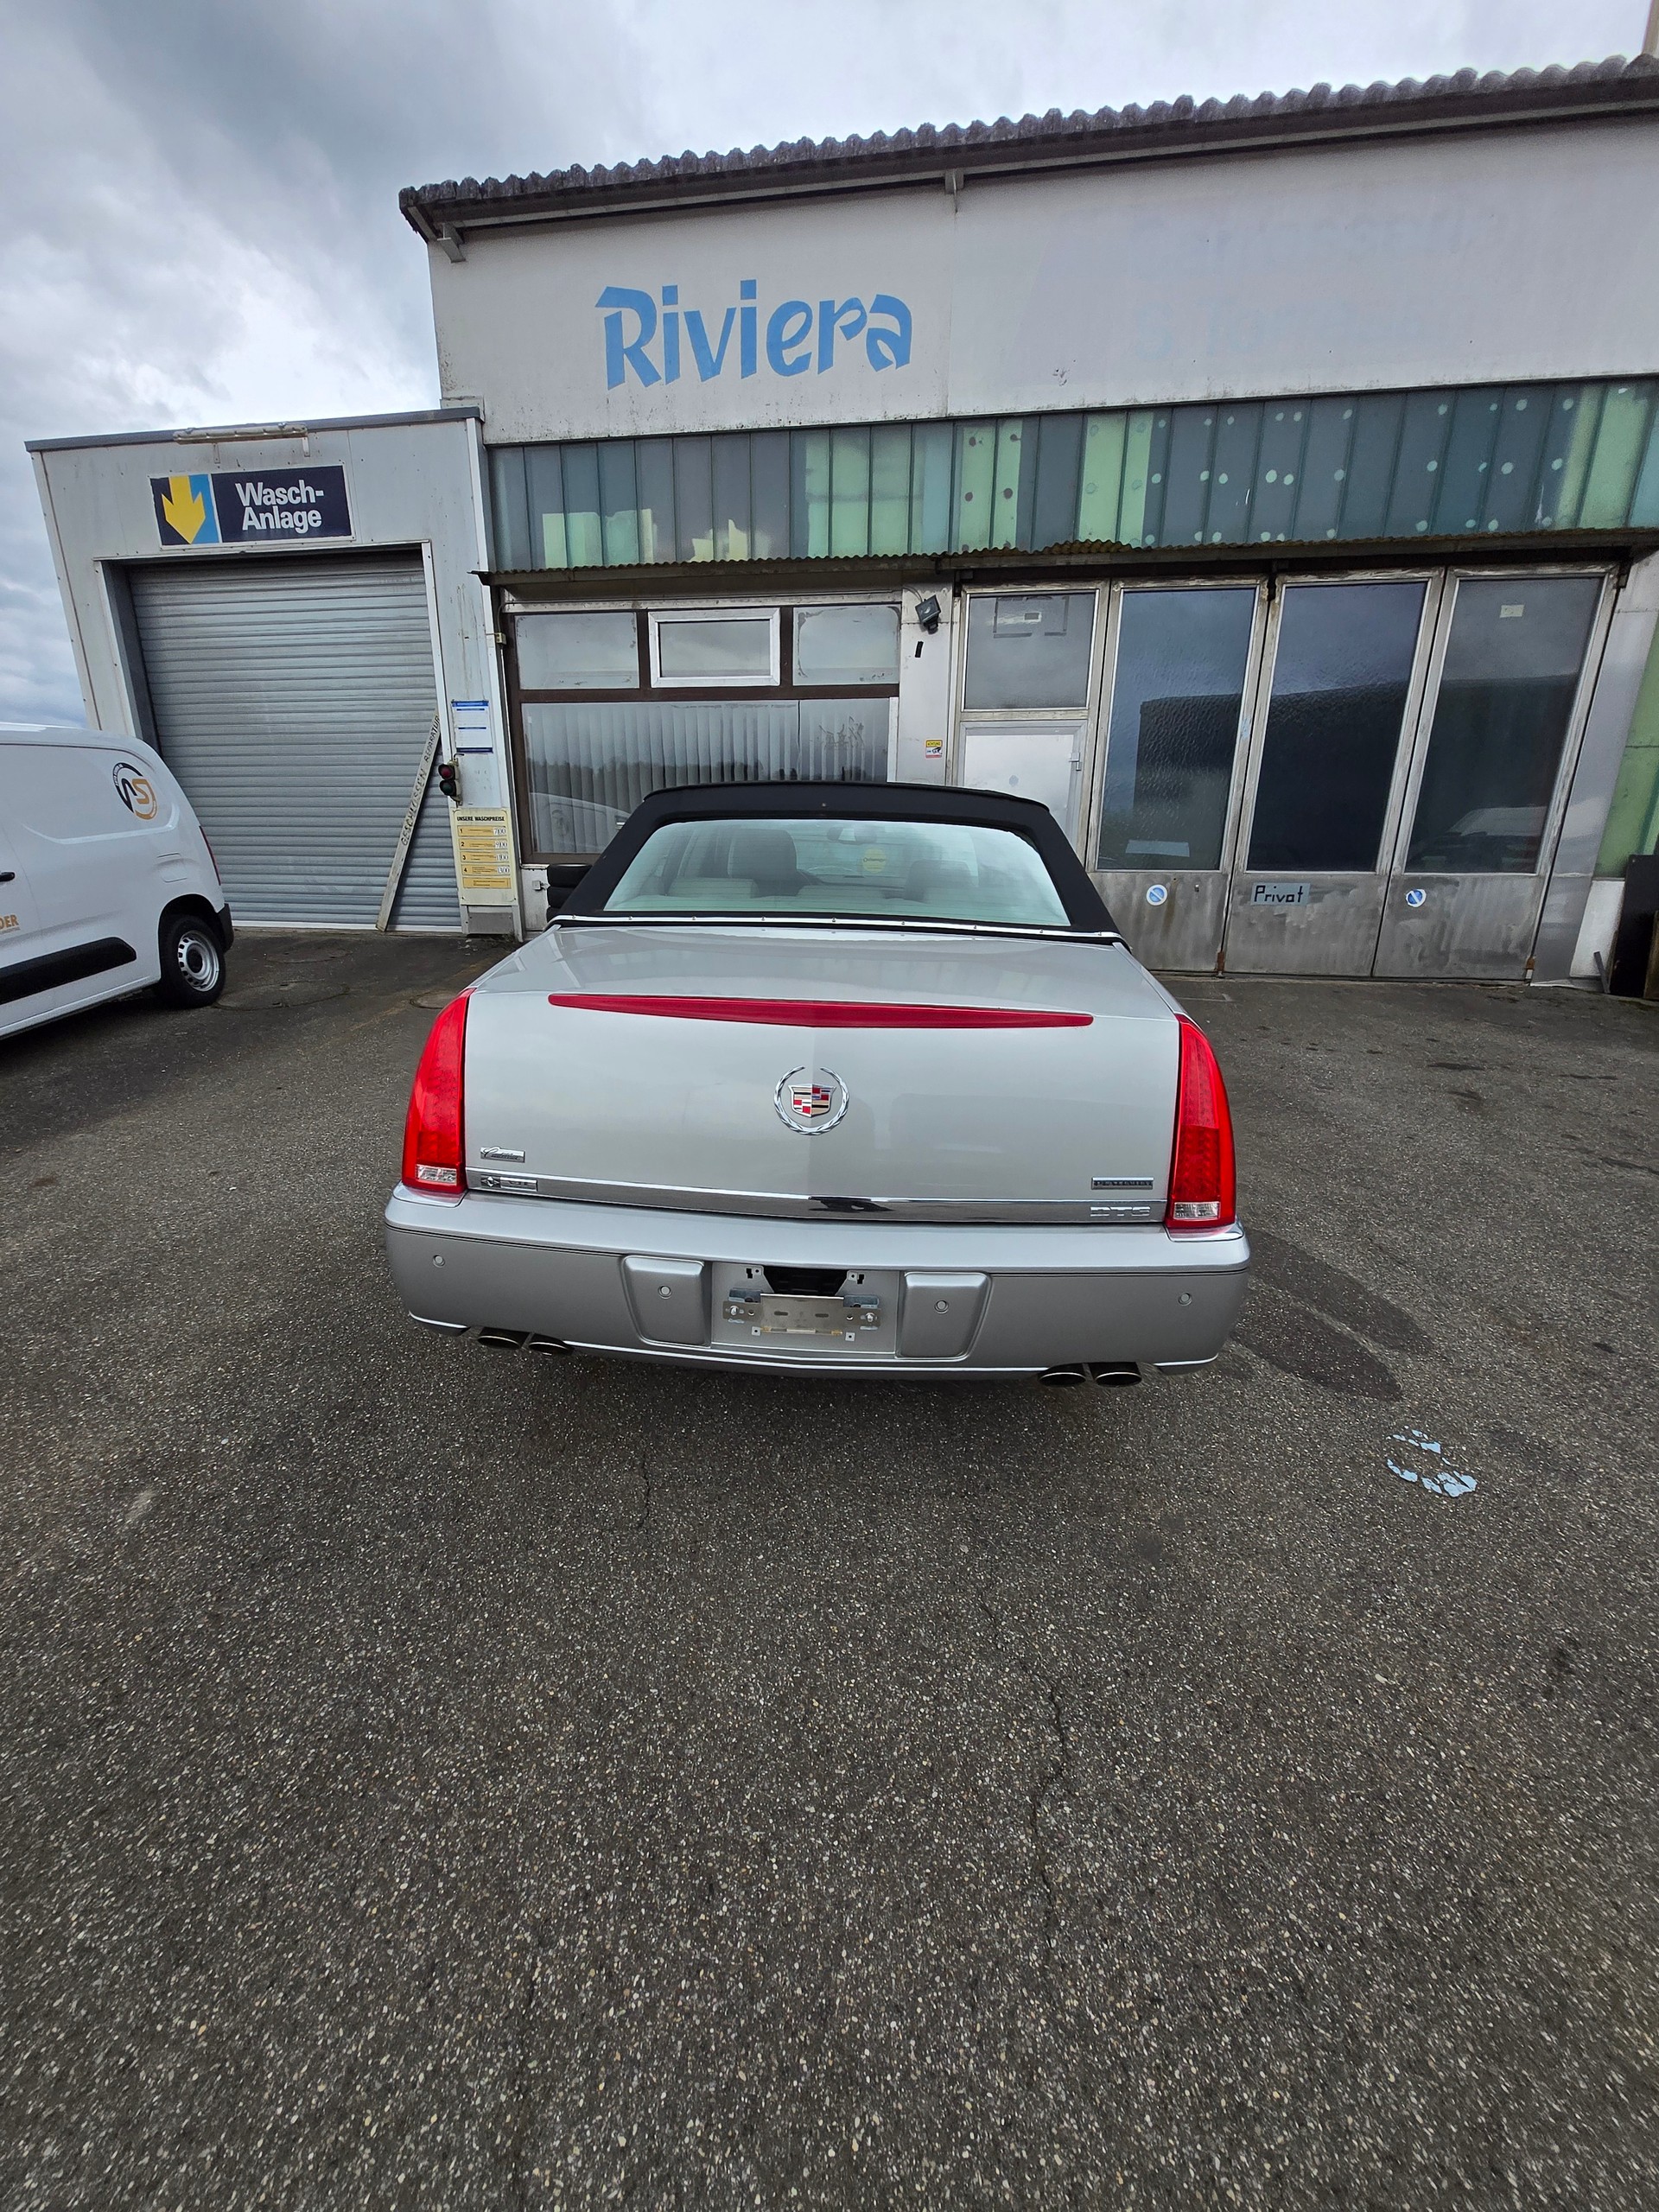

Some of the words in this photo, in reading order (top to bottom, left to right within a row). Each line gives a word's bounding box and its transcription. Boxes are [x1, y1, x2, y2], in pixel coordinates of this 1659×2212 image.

[595, 279, 912, 391] Riviera
[235, 480, 324, 506] Wasch-
[242, 505, 322, 534] Anlage
[1254, 885, 1303, 903] Privat
